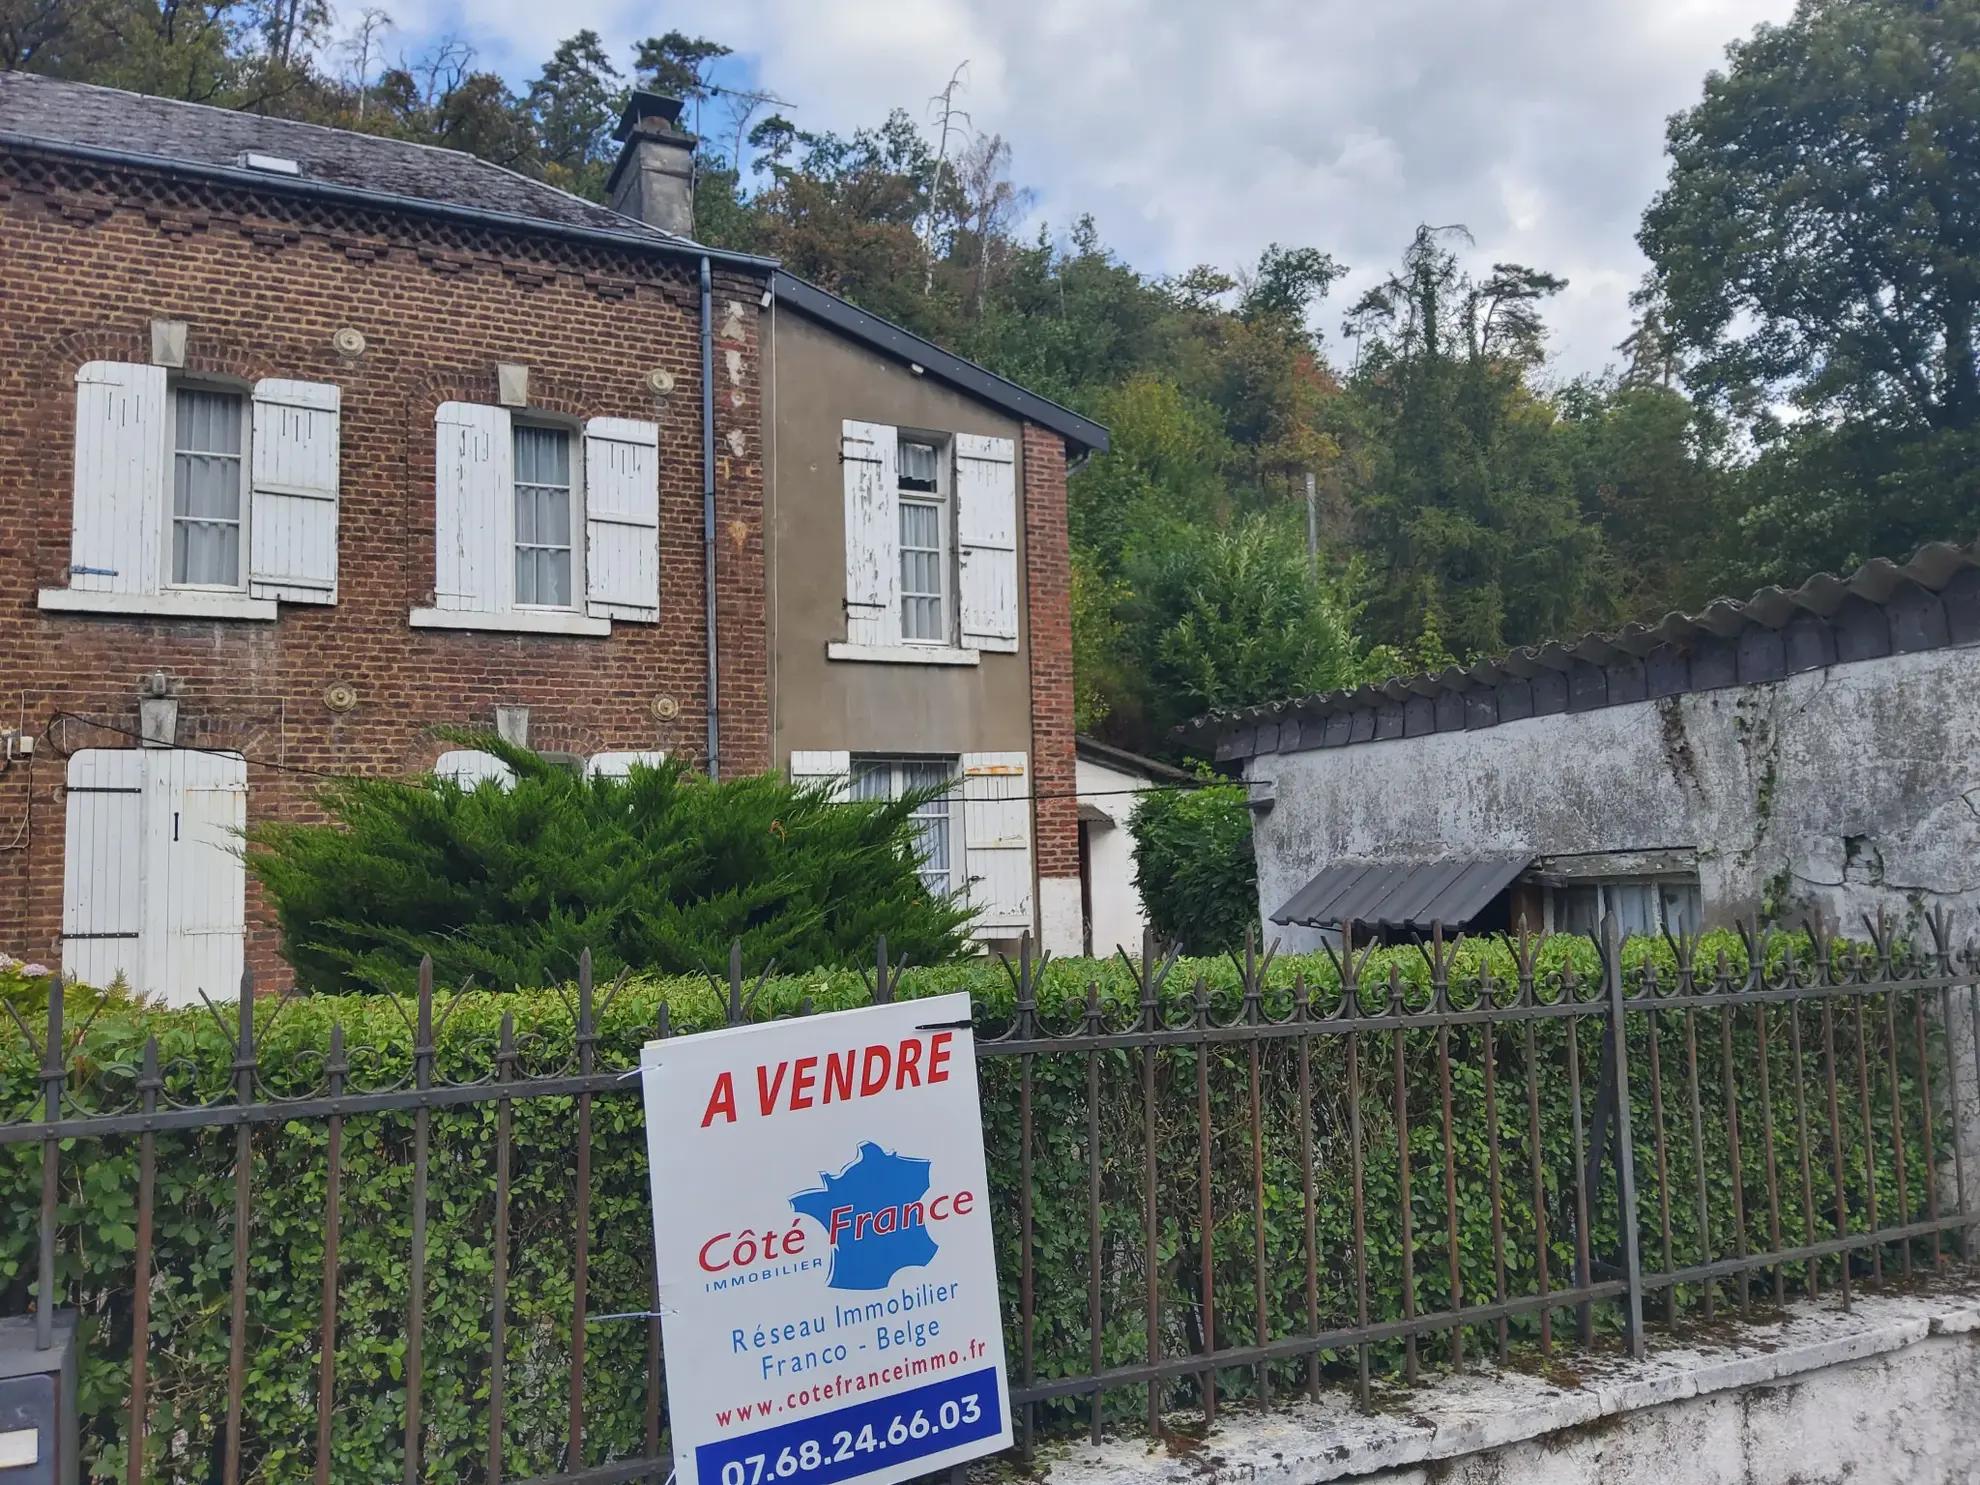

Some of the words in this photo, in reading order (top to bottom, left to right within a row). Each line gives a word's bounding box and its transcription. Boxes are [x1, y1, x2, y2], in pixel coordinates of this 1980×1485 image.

[700, 1071, 737, 1128] A
[756, 1032, 953, 1116] VENDRE
[698, 1218, 806, 1272] Côté
[829, 1190, 974, 1245] France
[705, 1257, 823, 1293] IMMOBILIER
[732, 1315, 825, 1354] Réseau
[835, 1280, 959, 1329] Immobilier
[761, 1345, 847, 1380] Franco
[877, 1318, 940, 1348] Belge
[715, 1338, 986, 1428] www.cotefranceimmo.fr
[721, 1393, 982, 1485] 07.68.24.66.03
